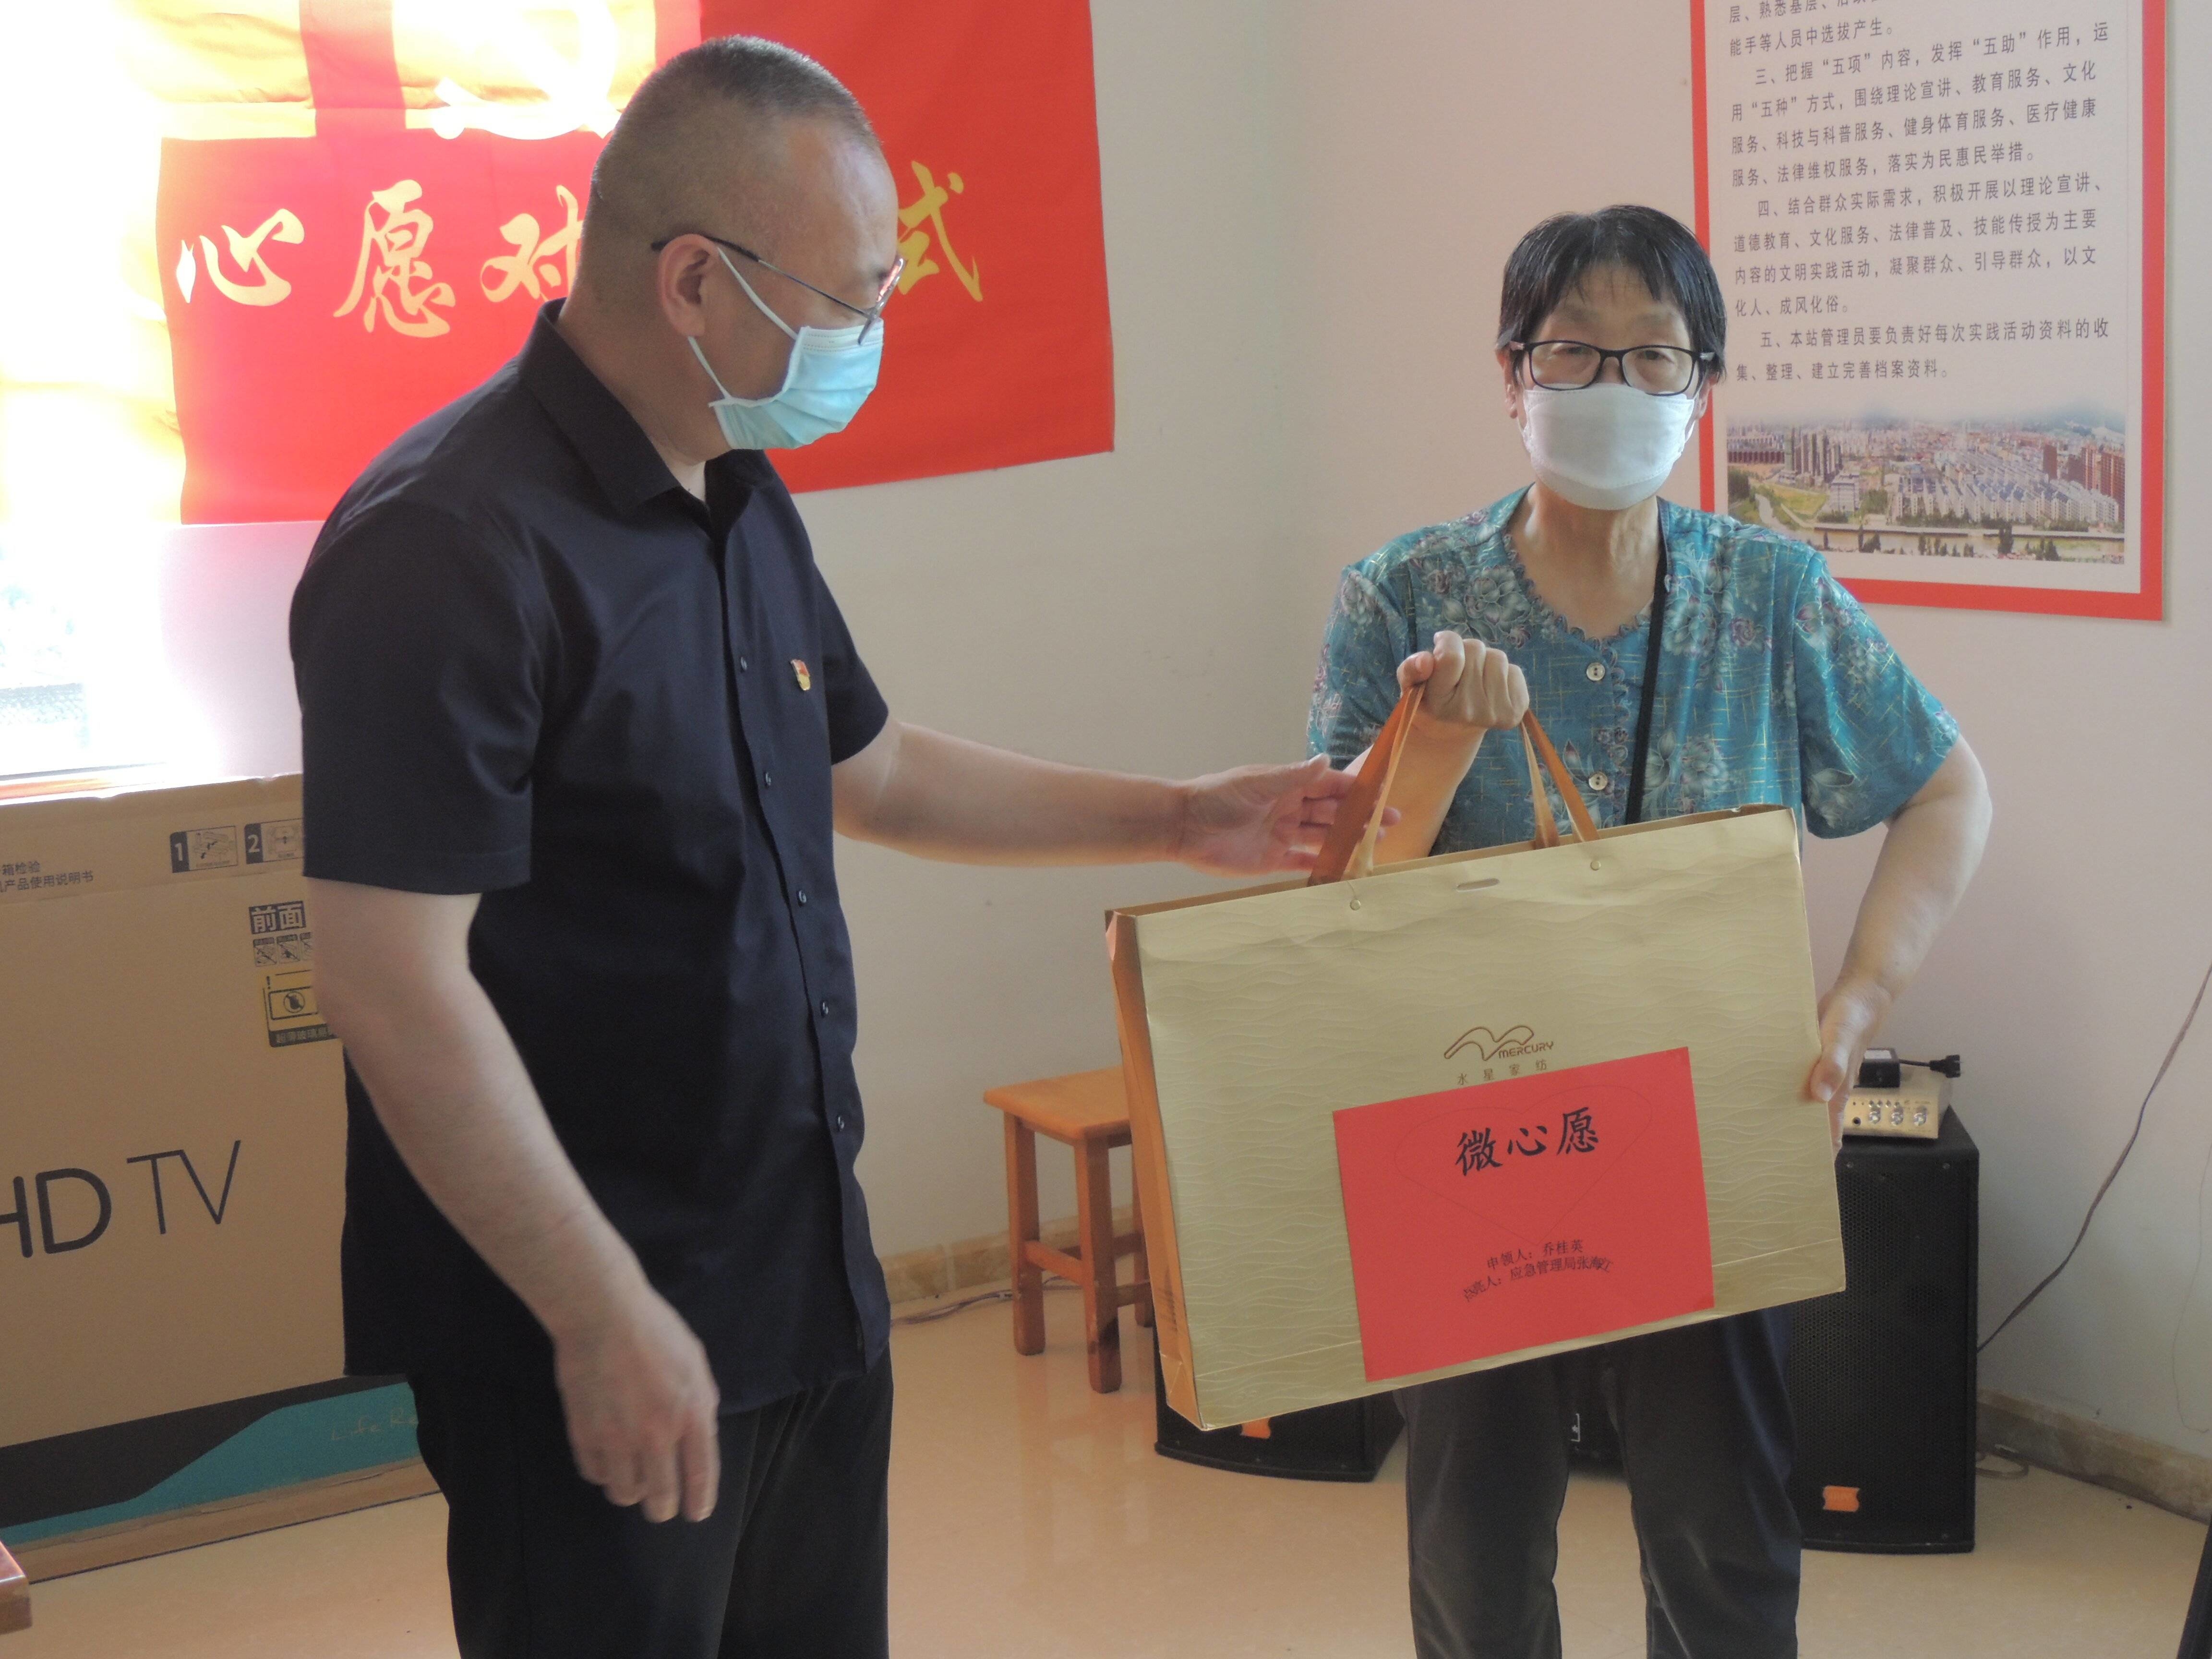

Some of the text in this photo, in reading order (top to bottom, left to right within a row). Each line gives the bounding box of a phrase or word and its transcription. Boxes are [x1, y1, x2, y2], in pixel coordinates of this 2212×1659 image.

[1730, 17, 1892, 57] 能手等人员中选拔产生。
[1731, 97, 2096, 154] 服务、科技与科普服务、健身体育服务、医疗健康
[1732, 141, 2033, 187] 服务、法律维权服务，落实为民惠民举措。
[1758, 171, 2101, 217] 四、结合群众实际需求，积极开展以理论宣讲、
[1734, 209, 2096, 252] 道德教育、文化服务、法律普及、技能传授为主要
[176, 160, 983, 338] 心愿对式
[1735, 245, 2096, 284] 内容的文明实践活动，凝聚群众、引导群众，以文
[1735, 295, 1848, 317] 化人、成风化俗。
[1760, 317, 2108, 348] 五、本站管理员要负责好每次实践活动资料的收
[1736, 359, 1947, 382] 集、整理、建立完善档案资料。
[175, 843, 183, 861] 1
[248, 834, 260, 854] 2
[0, 870, 94, 893] 产品使用说明书
[252, 903, 304, 933] 前面
[1498, 1041, 1554, 1059] MERCURY
[1457, 1059, 1547, 1085] 水星家纺
[1455, 1107, 1600, 1177] 微心愿
[126, 1140, 241, 1235] TV
